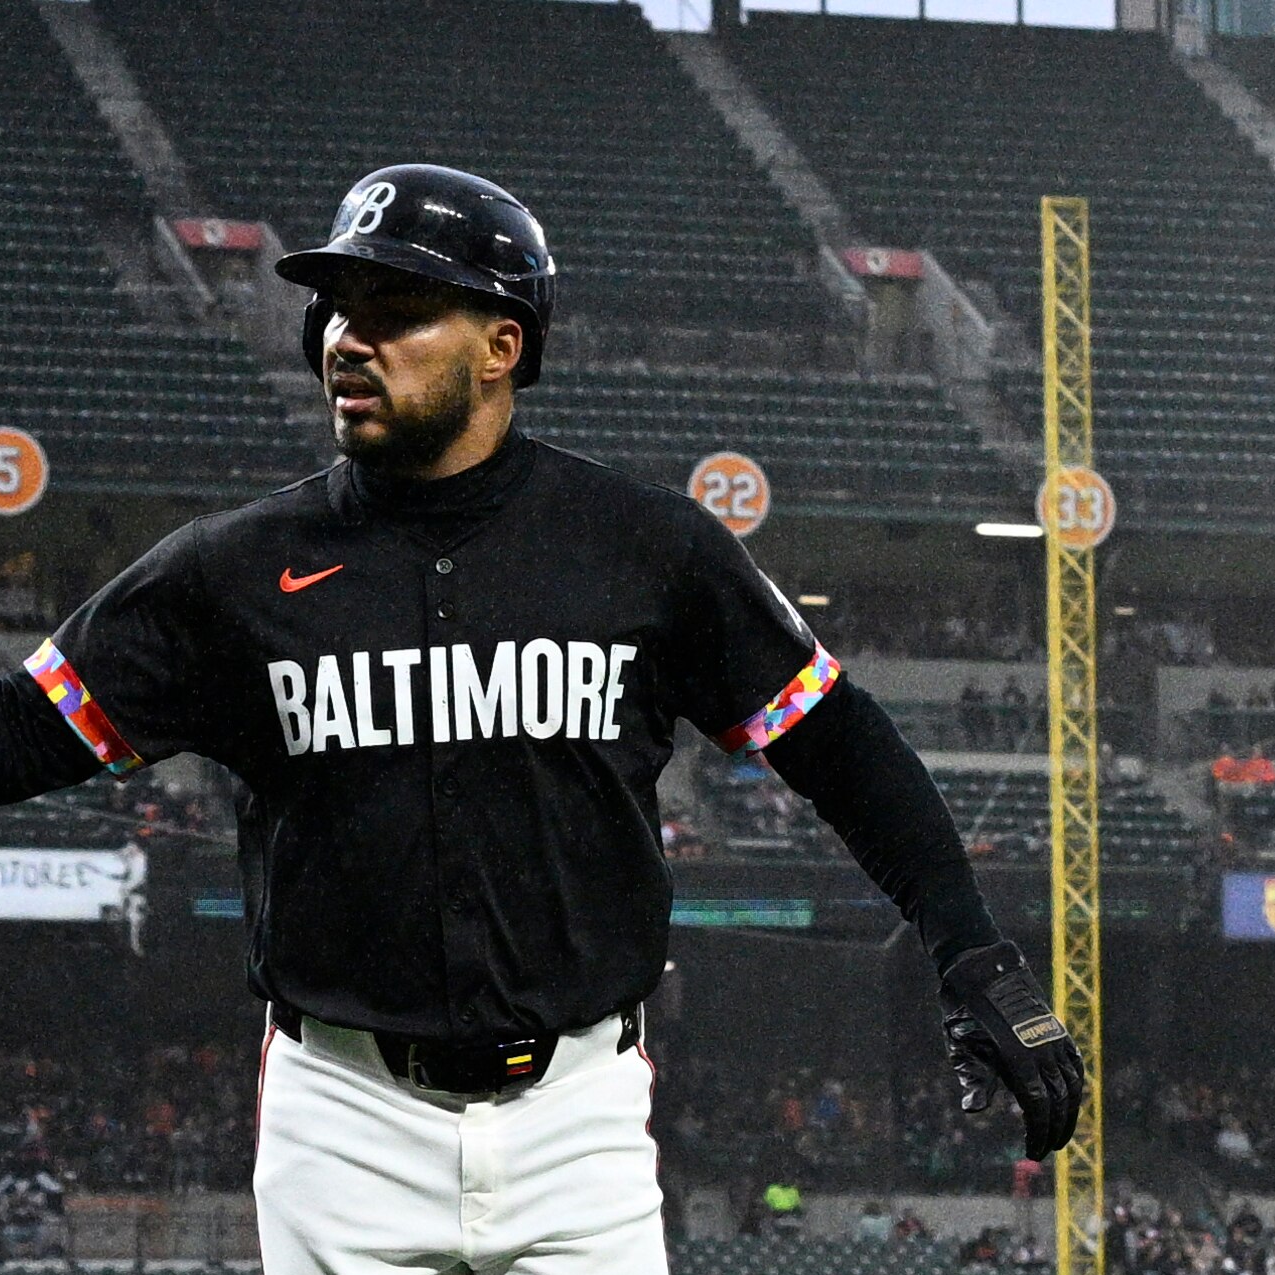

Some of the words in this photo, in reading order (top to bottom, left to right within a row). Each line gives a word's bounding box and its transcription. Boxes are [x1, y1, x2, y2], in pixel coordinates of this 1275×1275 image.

[346, 181, 397, 240] B
[703, 470, 757, 518] 22
[1056, 485, 1104, 530] 33
[266, 637, 639, 757] BALTIMORE
